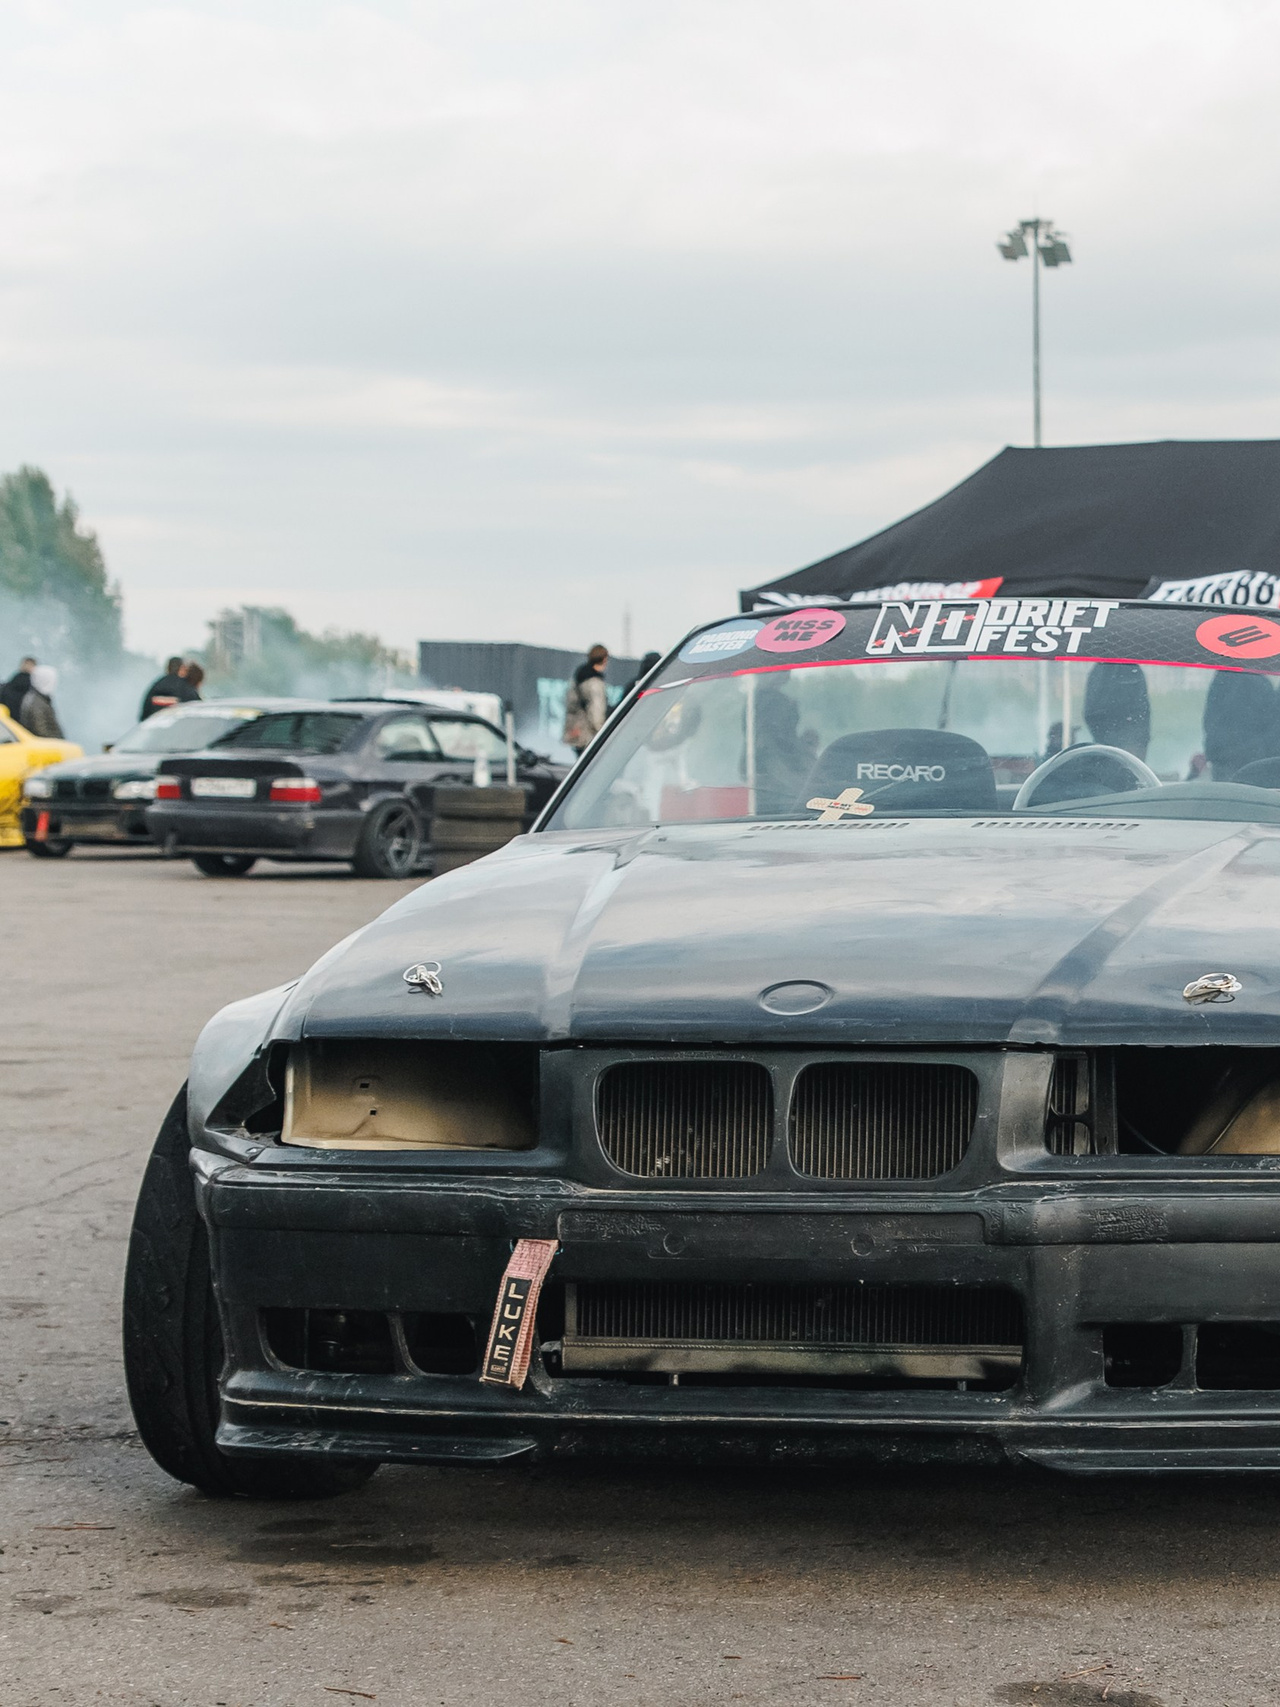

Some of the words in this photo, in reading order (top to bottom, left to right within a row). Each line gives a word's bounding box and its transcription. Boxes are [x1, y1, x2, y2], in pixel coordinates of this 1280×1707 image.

[982, 601, 1119, 627] DRIFT
[774, 620, 836, 630] KISS
[773, 631, 817, 641] ME
[975, 626, 1092, 653] FEST
[857, 763, 946, 782] RECARO
